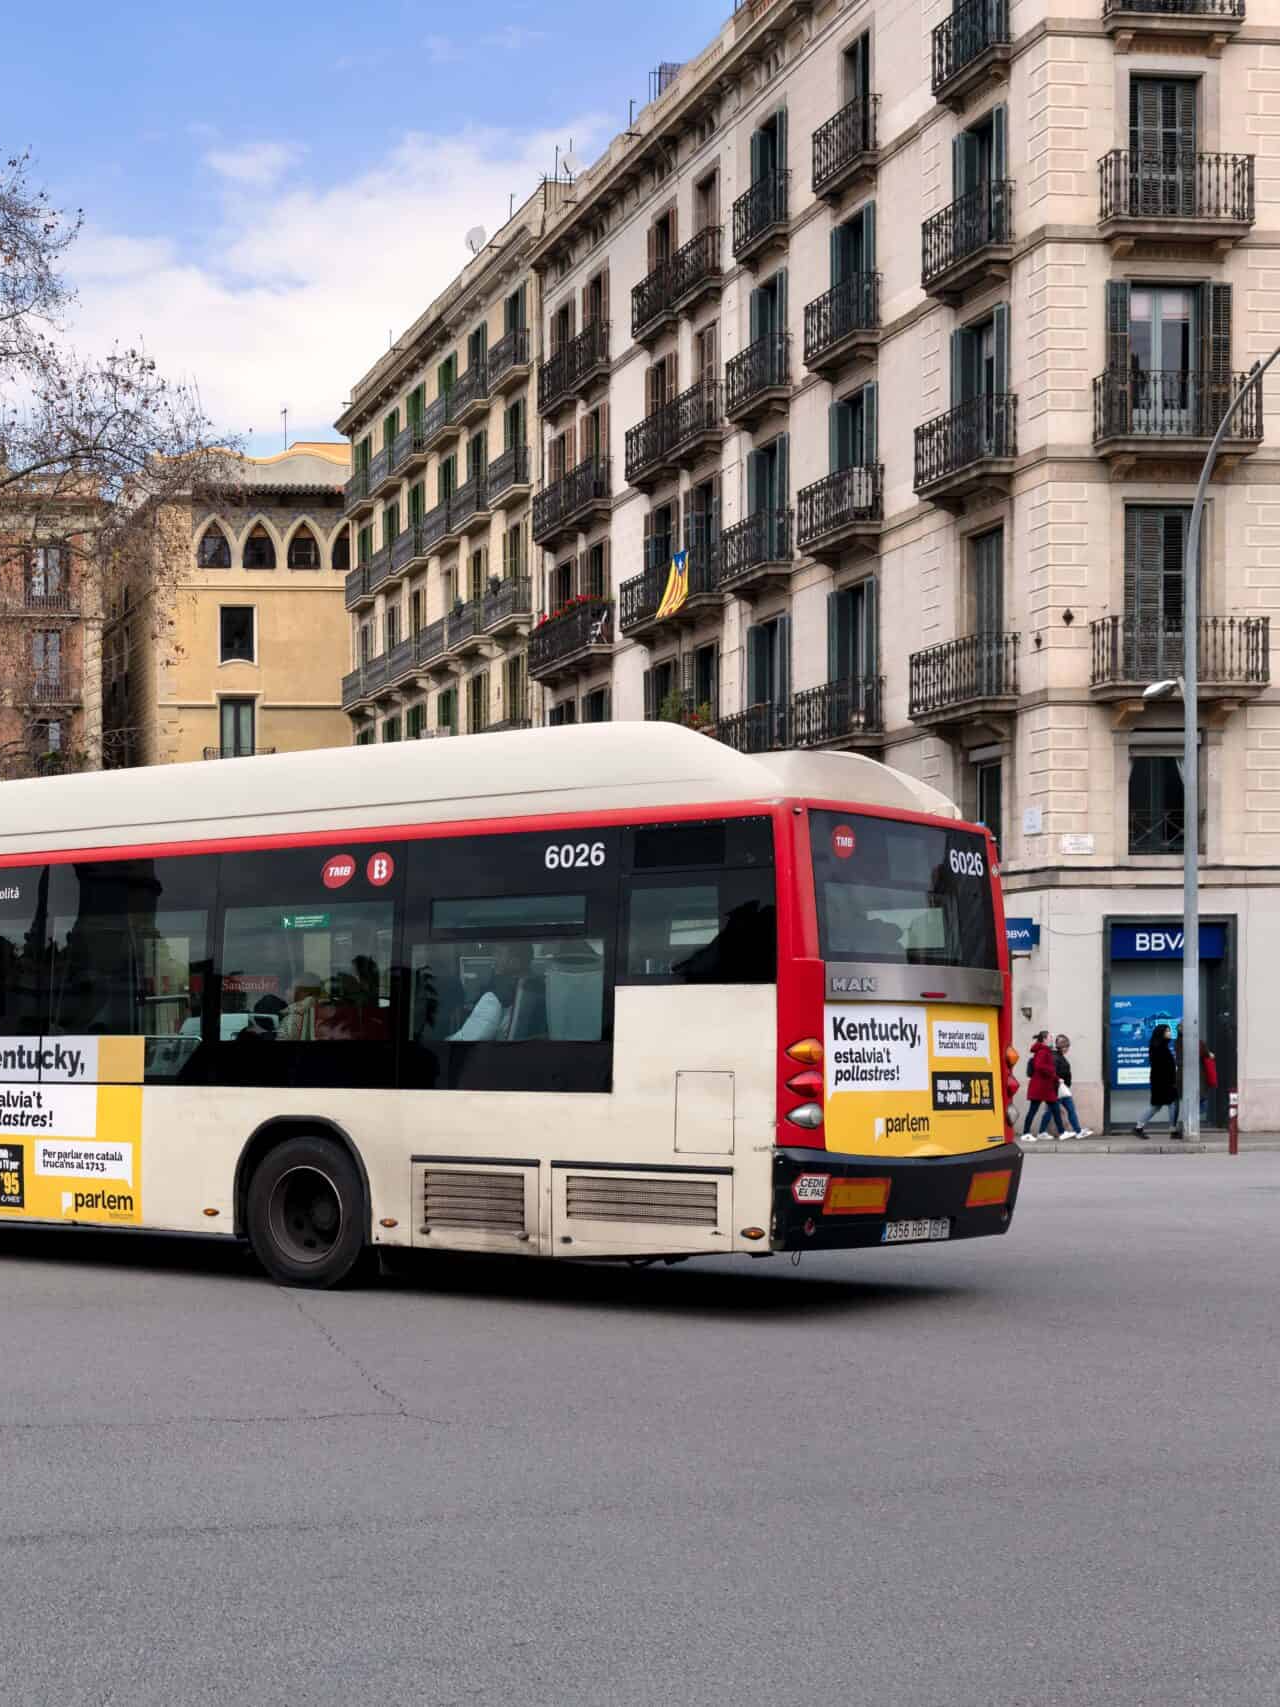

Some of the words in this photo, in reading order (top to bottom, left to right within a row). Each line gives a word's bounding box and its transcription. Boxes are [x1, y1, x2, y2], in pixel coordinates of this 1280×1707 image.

[836, 836, 854, 848] TMB
[545, 842, 606, 870] 6026
[950, 849, 984, 877] 6026
[329, 866, 351, 877] TMB
[373, 859, 388, 880] B
[831, 976, 878, 992] MAN
[832, 1016, 921, 1048] Kentucky,
[834, 1047, 891, 1064] estalvia't
[834, 1064, 900, 1086] pollastres!
[885, 1113, 930, 1138] parlem
[42, 1148, 56, 1159] Per
[57, 1149, 83, 1160] parlar
[83, 1152, 95, 1161] en
[43, 1159, 75, 1169] truca'ns
[76, 1160, 85, 1170] al
[74, 1190, 134, 1213] parlem
[887, 1222, 910, 1240] 2356
